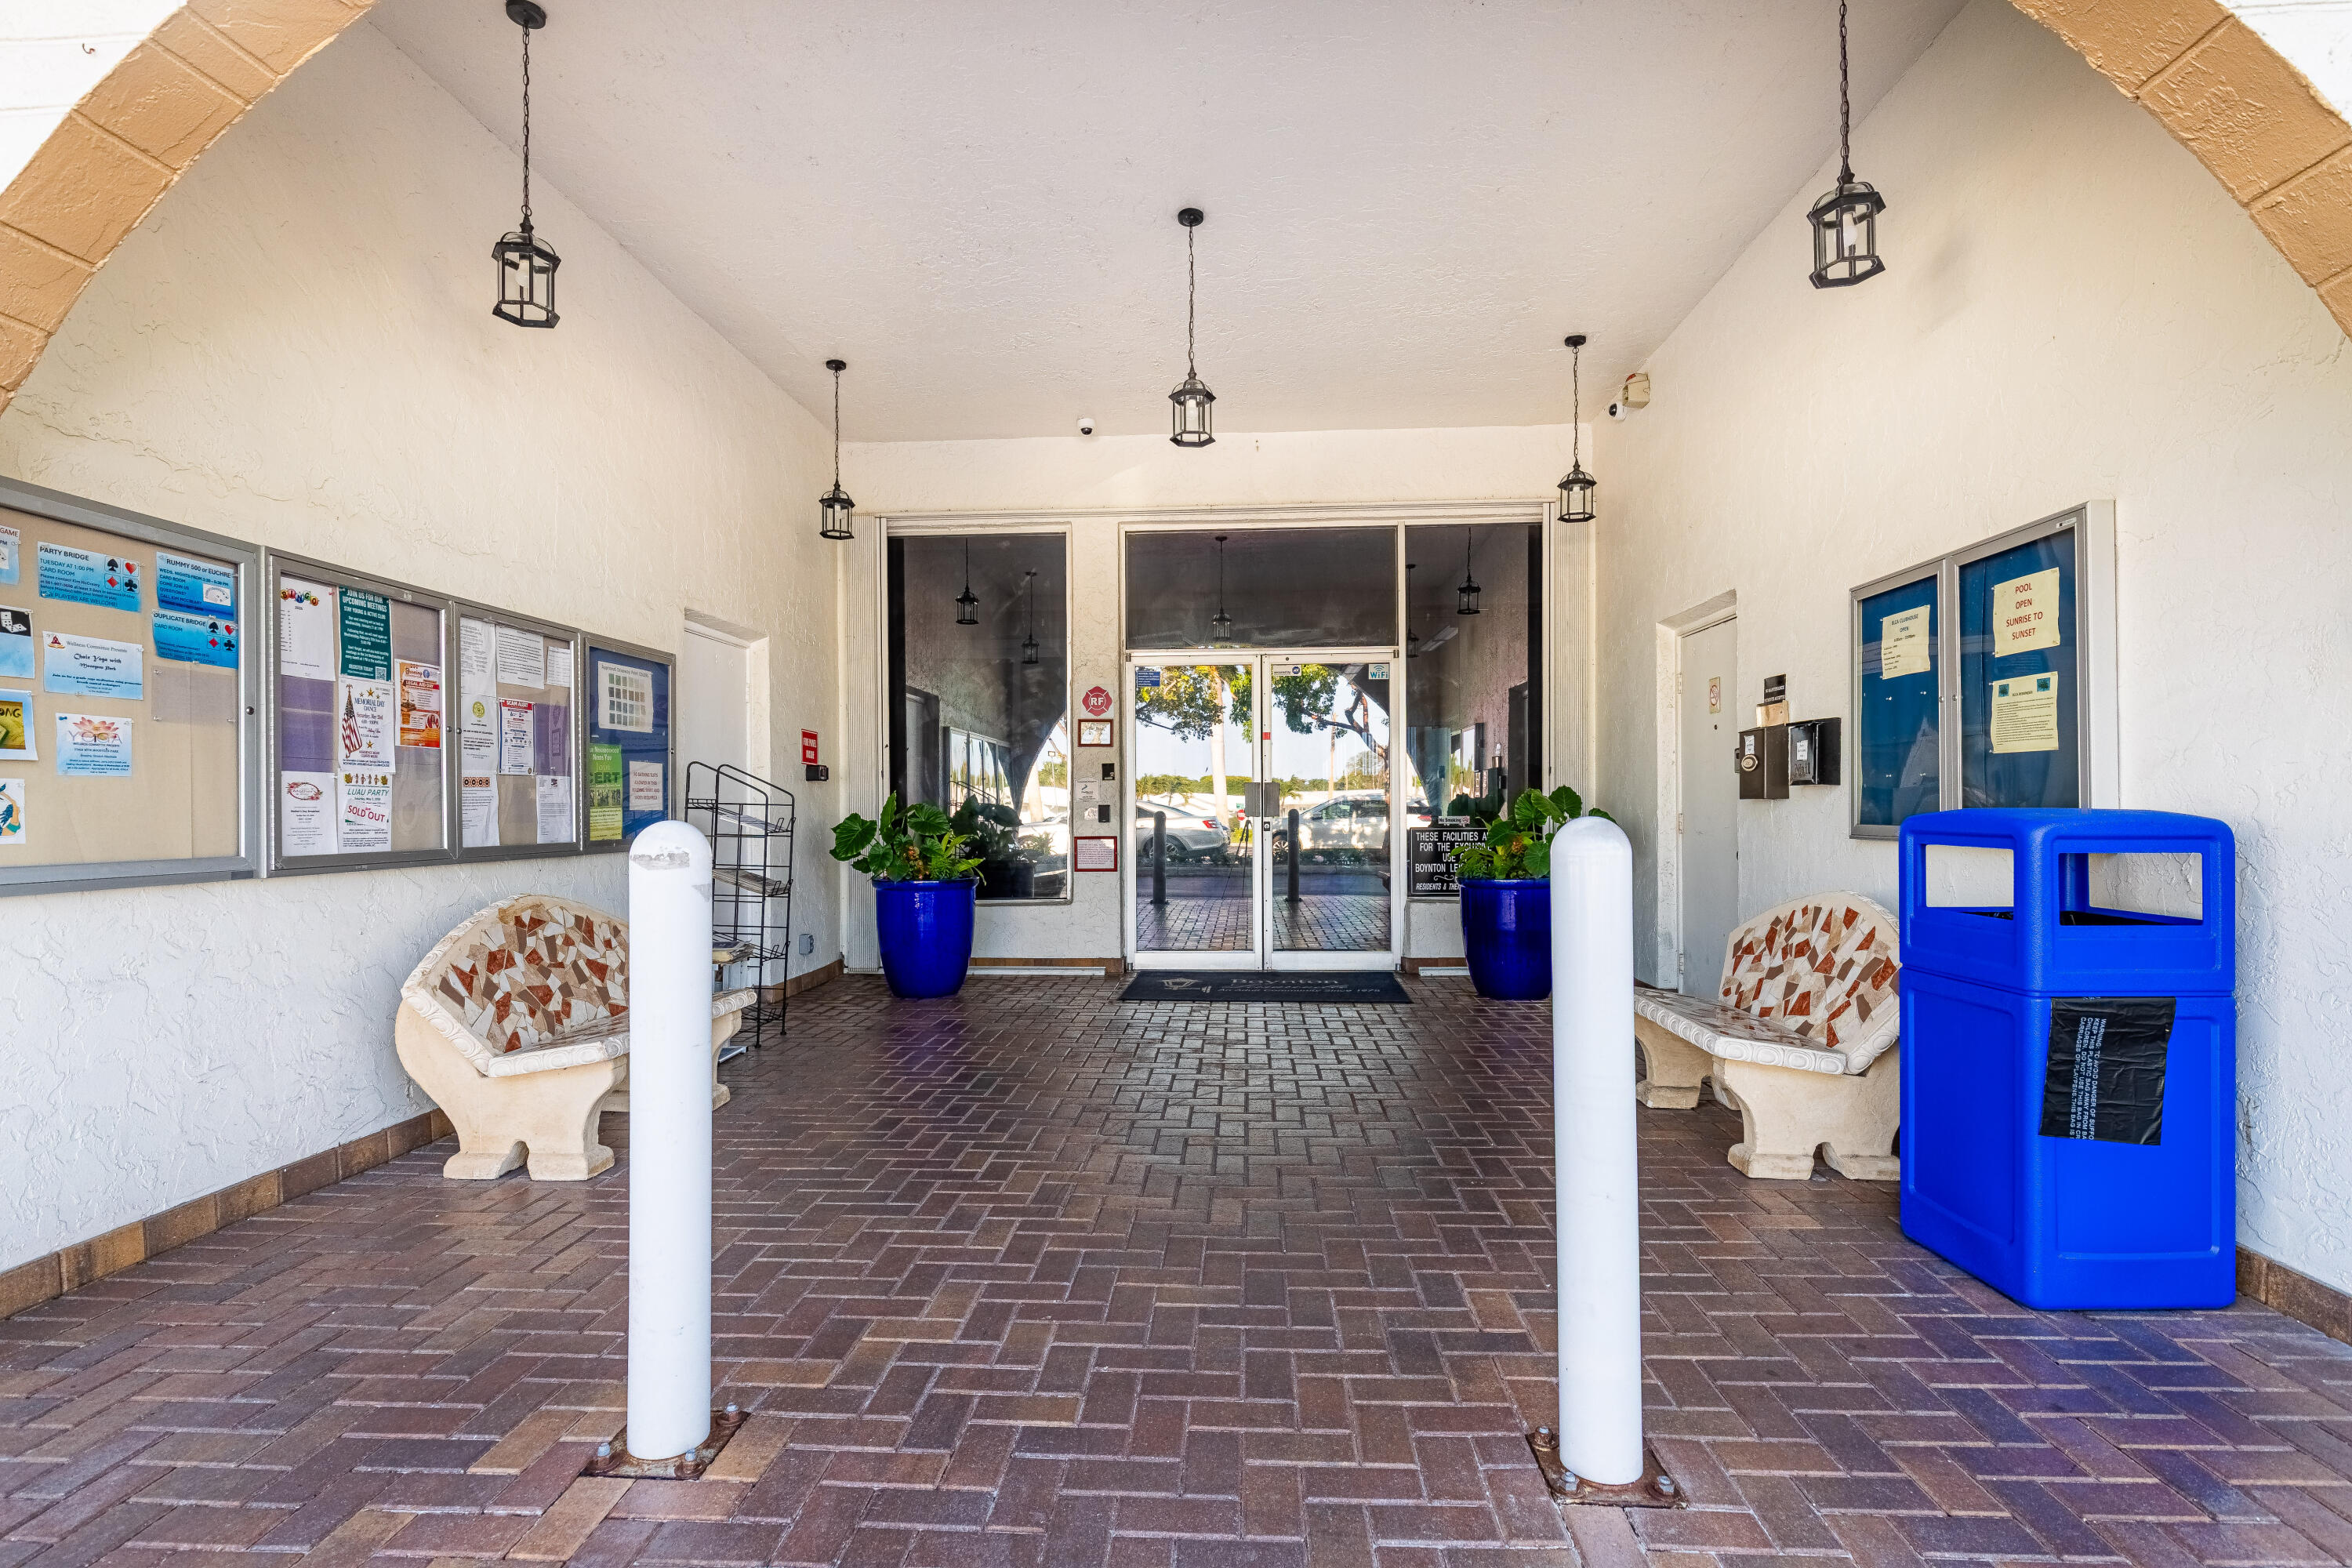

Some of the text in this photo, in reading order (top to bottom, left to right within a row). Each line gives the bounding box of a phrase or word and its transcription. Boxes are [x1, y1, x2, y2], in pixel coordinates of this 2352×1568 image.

[0, 528, 18, 537] GAME
[40, 546, 89, 561] PARTY BRIDGE
[40, 558, 66, 568] TUESDAY
[167, 559, 190, 568] RUMMY
[209, 568, 230, 578] EUCHRE
[2016, 583, 2032, 593] POOL
[55, 592, 78, 601] PLAYERS
[90, 597, 118, 607] WELCOME!
[281, 589, 318, 606] BINGO
[2016, 598, 2032, 609] OPEN
[343, 596, 387, 612] UPCOMING MEETINGS
[154, 613, 185, 622] DUPLICATE
[1900, 614, 1918, 622] CLUBHOUSE
[2006, 612, 2042, 627] SUNRISE TO
[2013, 628, 2036, 640] SUNSET
[354, 698, 376, 706] MEMORIAL
[68, 731, 122, 744] YOGA
[1795, 763, 1810, 775] Mail
[348, 805, 386, 822] SOLD OUT
[1443, 832, 1479, 840] FACILITIES
[1420, 843, 1433, 851] FOR
[1437, 843, 1450, 851] THE
[2075, 1017, 2086, 1052] CARRIAGES
[2096, 1018, 2107, 1049] WARNING:
[2075, 1054, 2081, 1062] OR
[2082, 1051, 2087, 1060] DO
